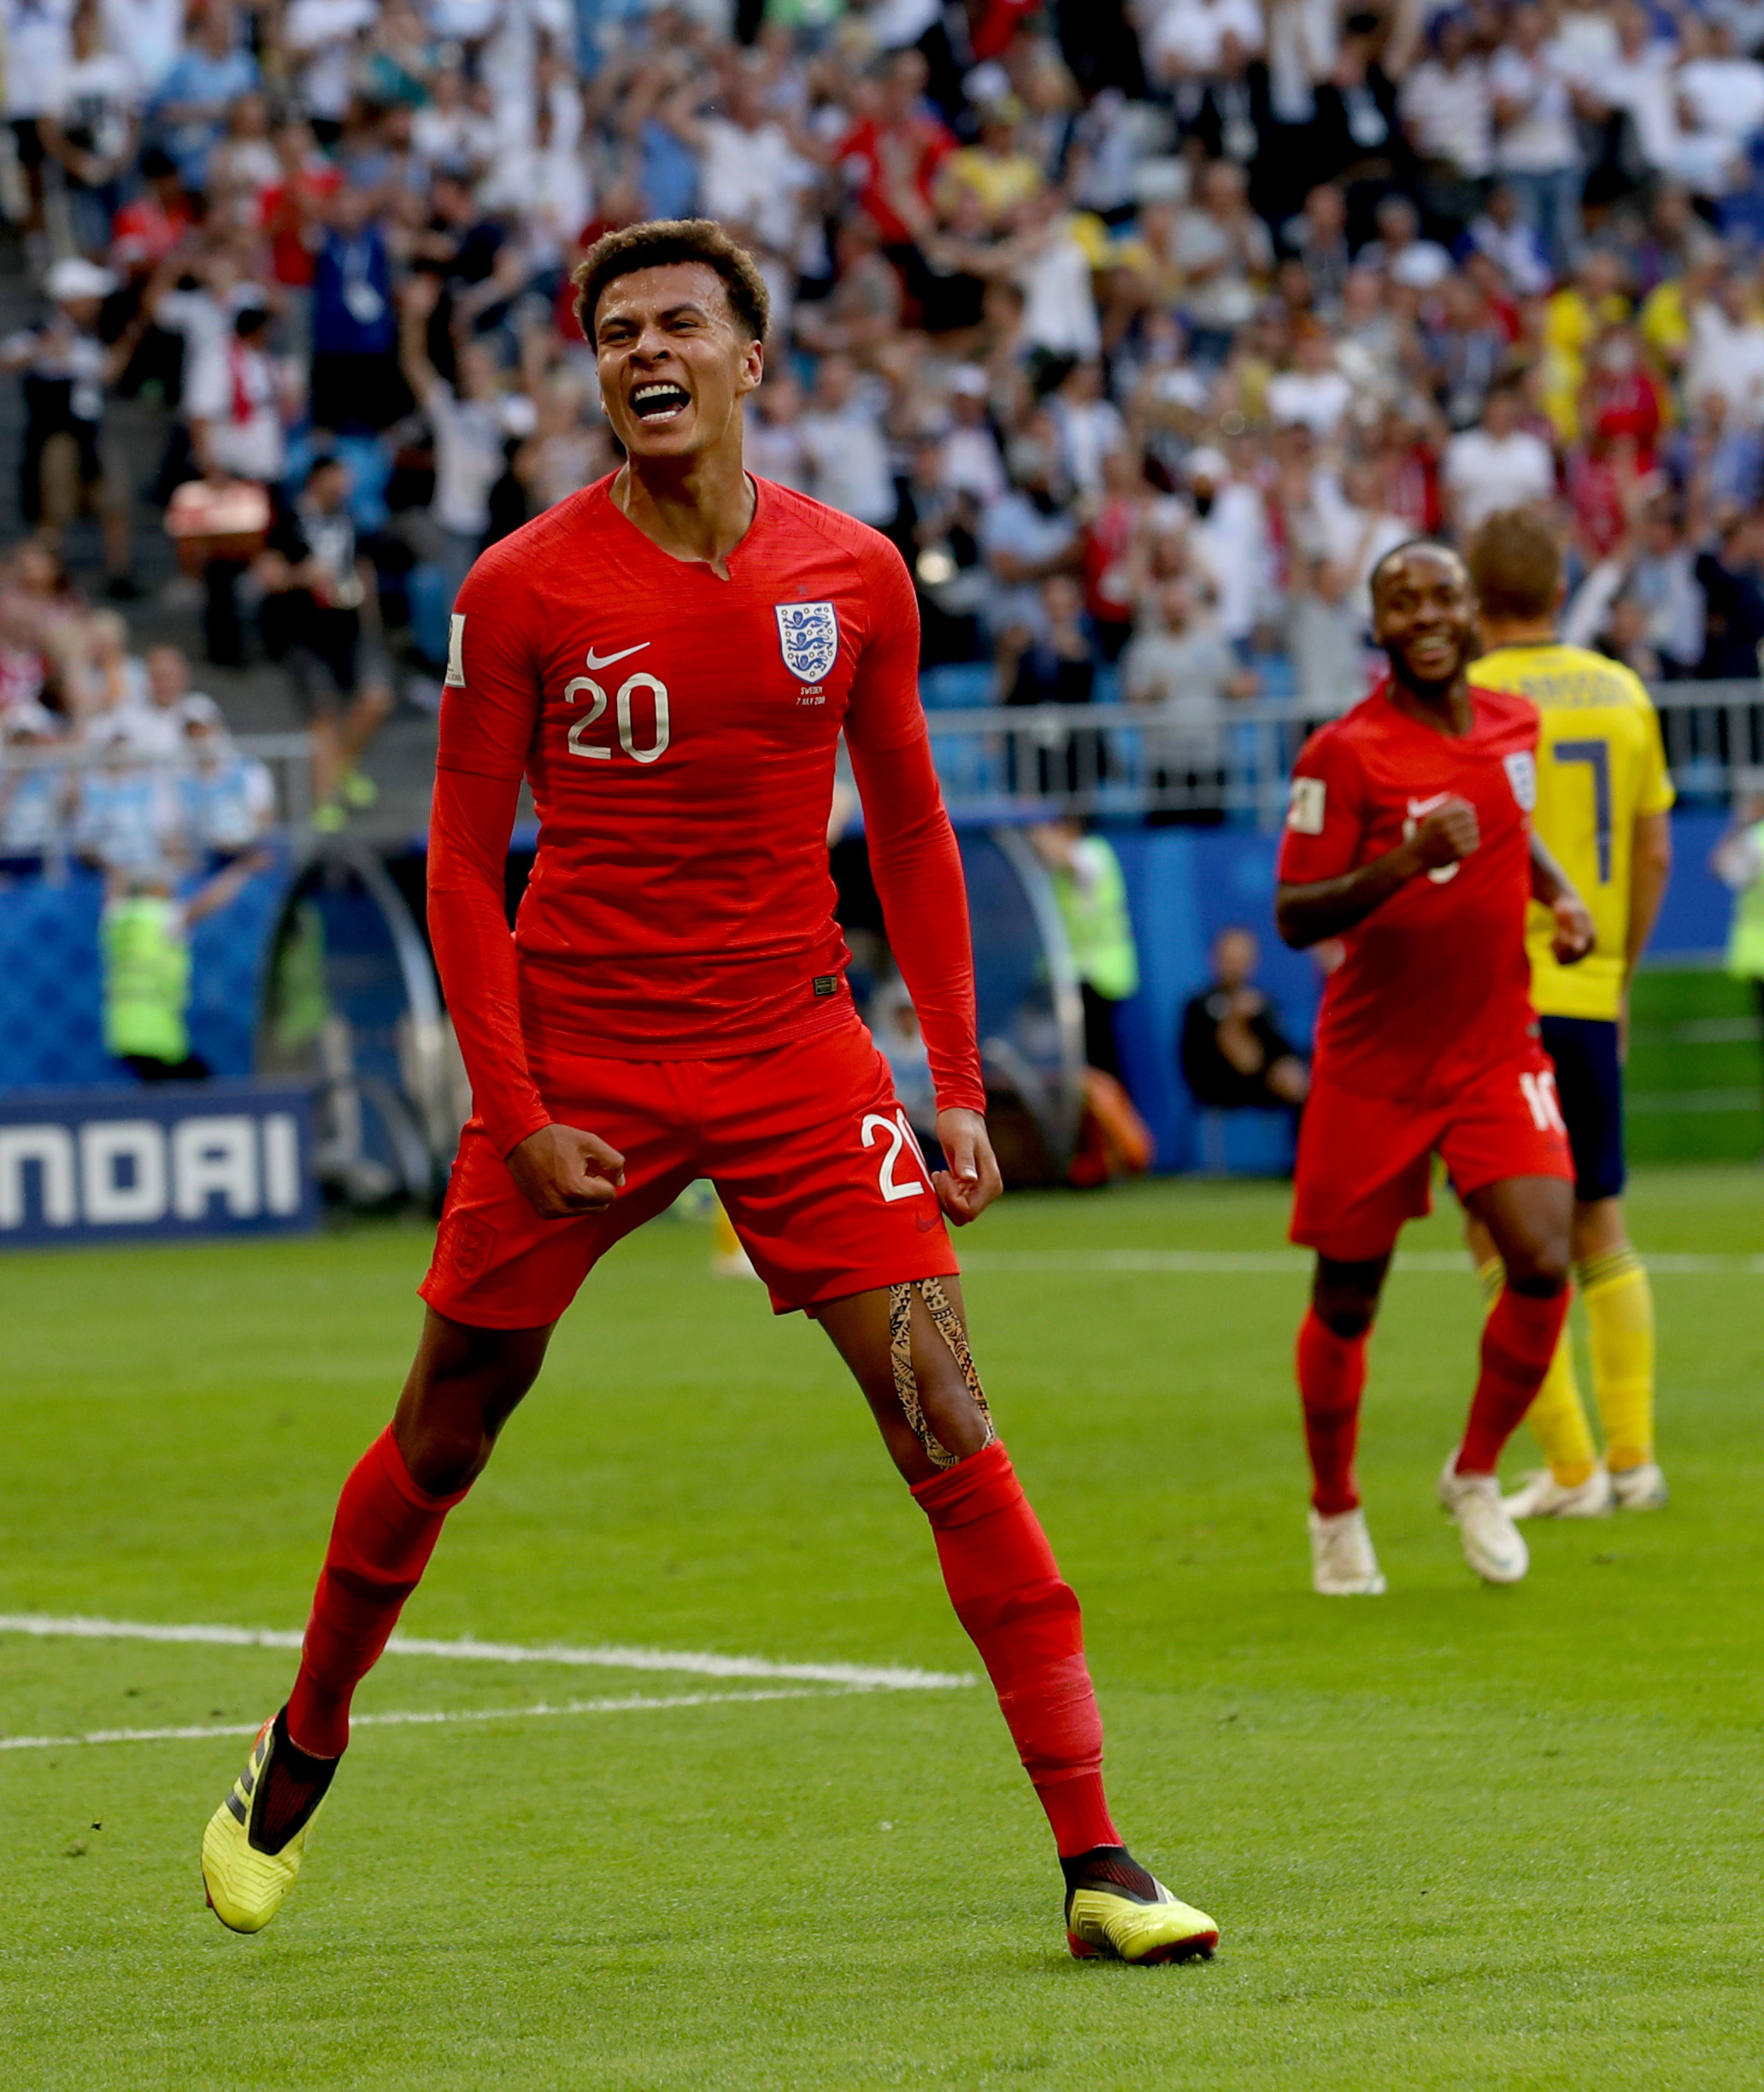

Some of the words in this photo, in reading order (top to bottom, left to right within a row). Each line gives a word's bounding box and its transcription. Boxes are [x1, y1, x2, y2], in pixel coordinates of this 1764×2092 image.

[564, 672, 669, 763] 20
[800, 685, 823, 695] SWEDEN
[1554, 739, 1610, 884] 7
